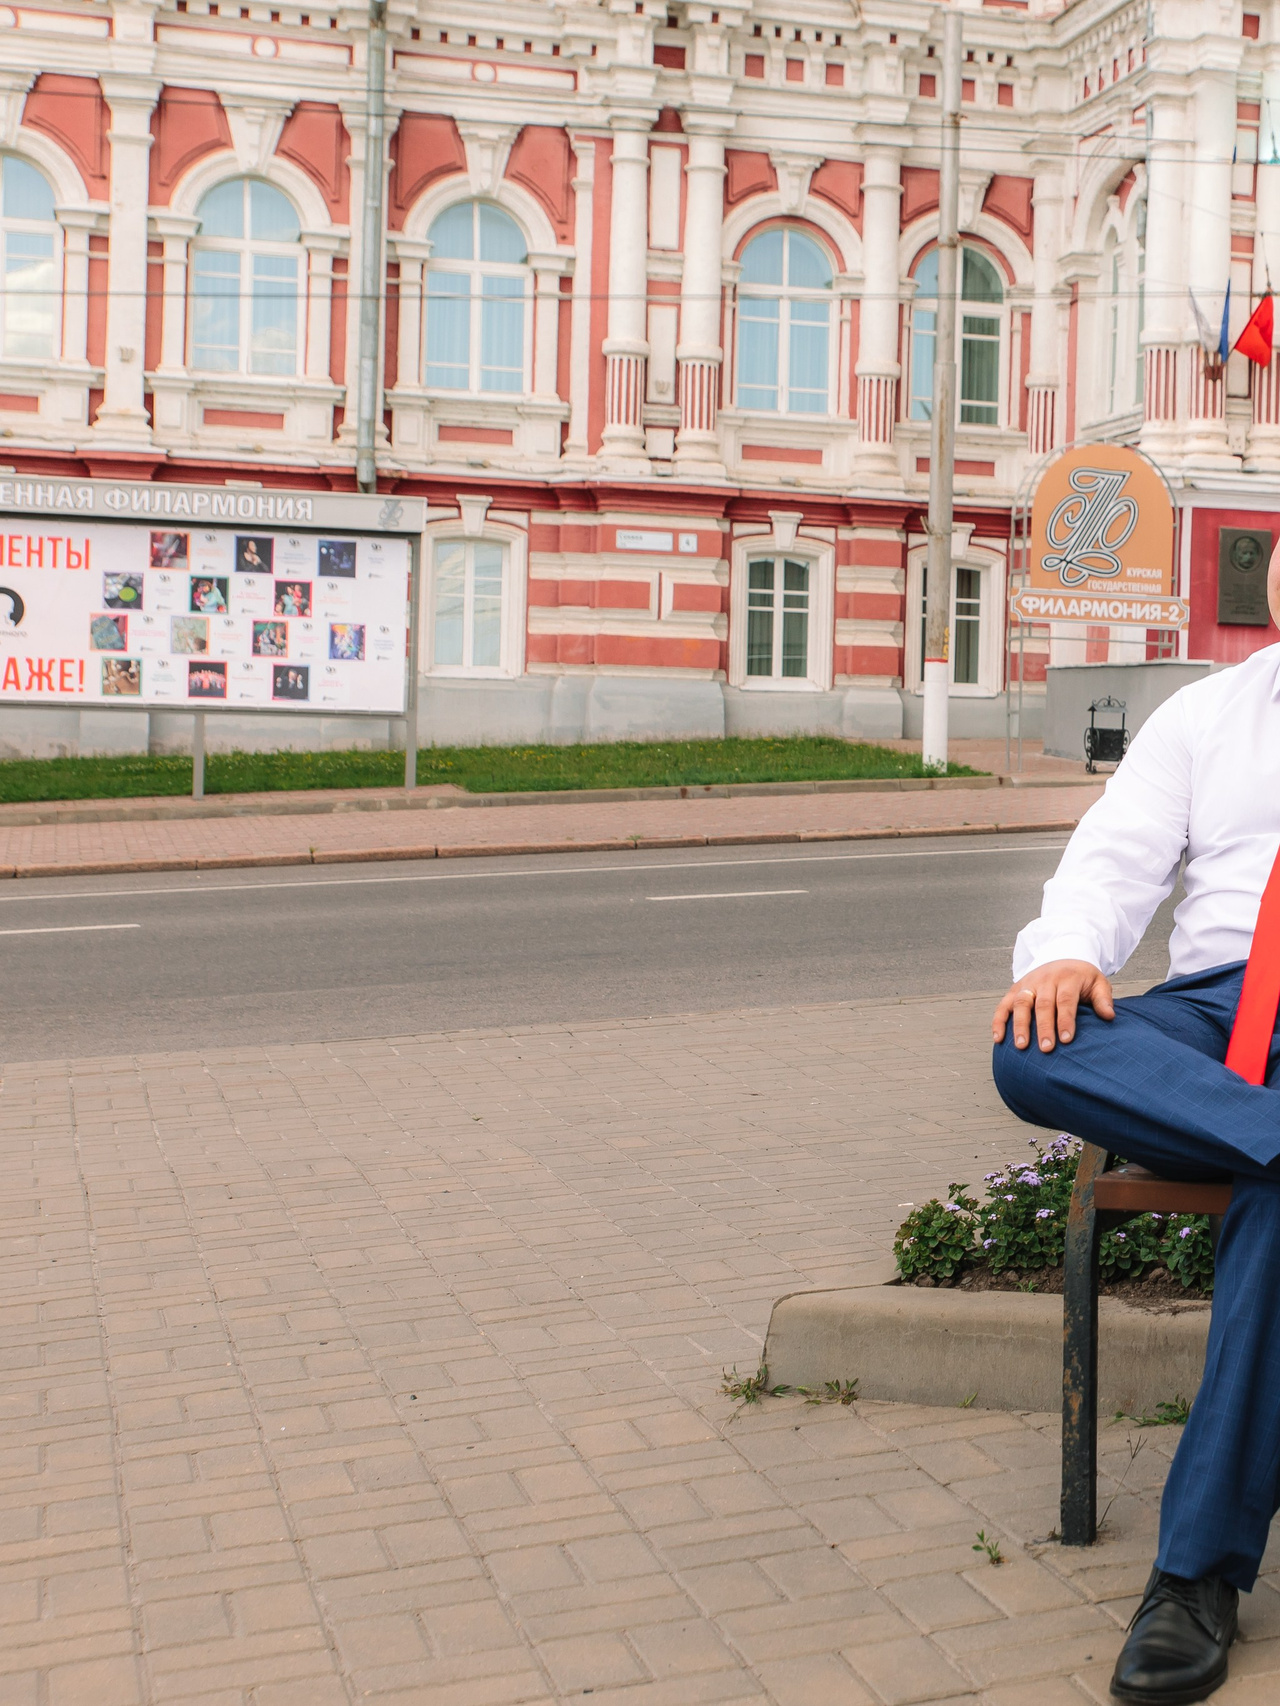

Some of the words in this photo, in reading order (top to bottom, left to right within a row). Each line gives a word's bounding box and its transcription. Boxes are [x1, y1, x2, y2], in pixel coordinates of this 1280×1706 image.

[104, 487, 314, 521] ФИЛАРМОНИЯ
[1126, 567, 1163, 579] КУРСКАЯ
[1087, 580, 1162, 594] ГОСУДАРСТВЕННАЯ
[1021, 596, 1180, 622] ФИЛАРМОНИЯ-2
[2, 657, 84, 692] АЖЕ!
